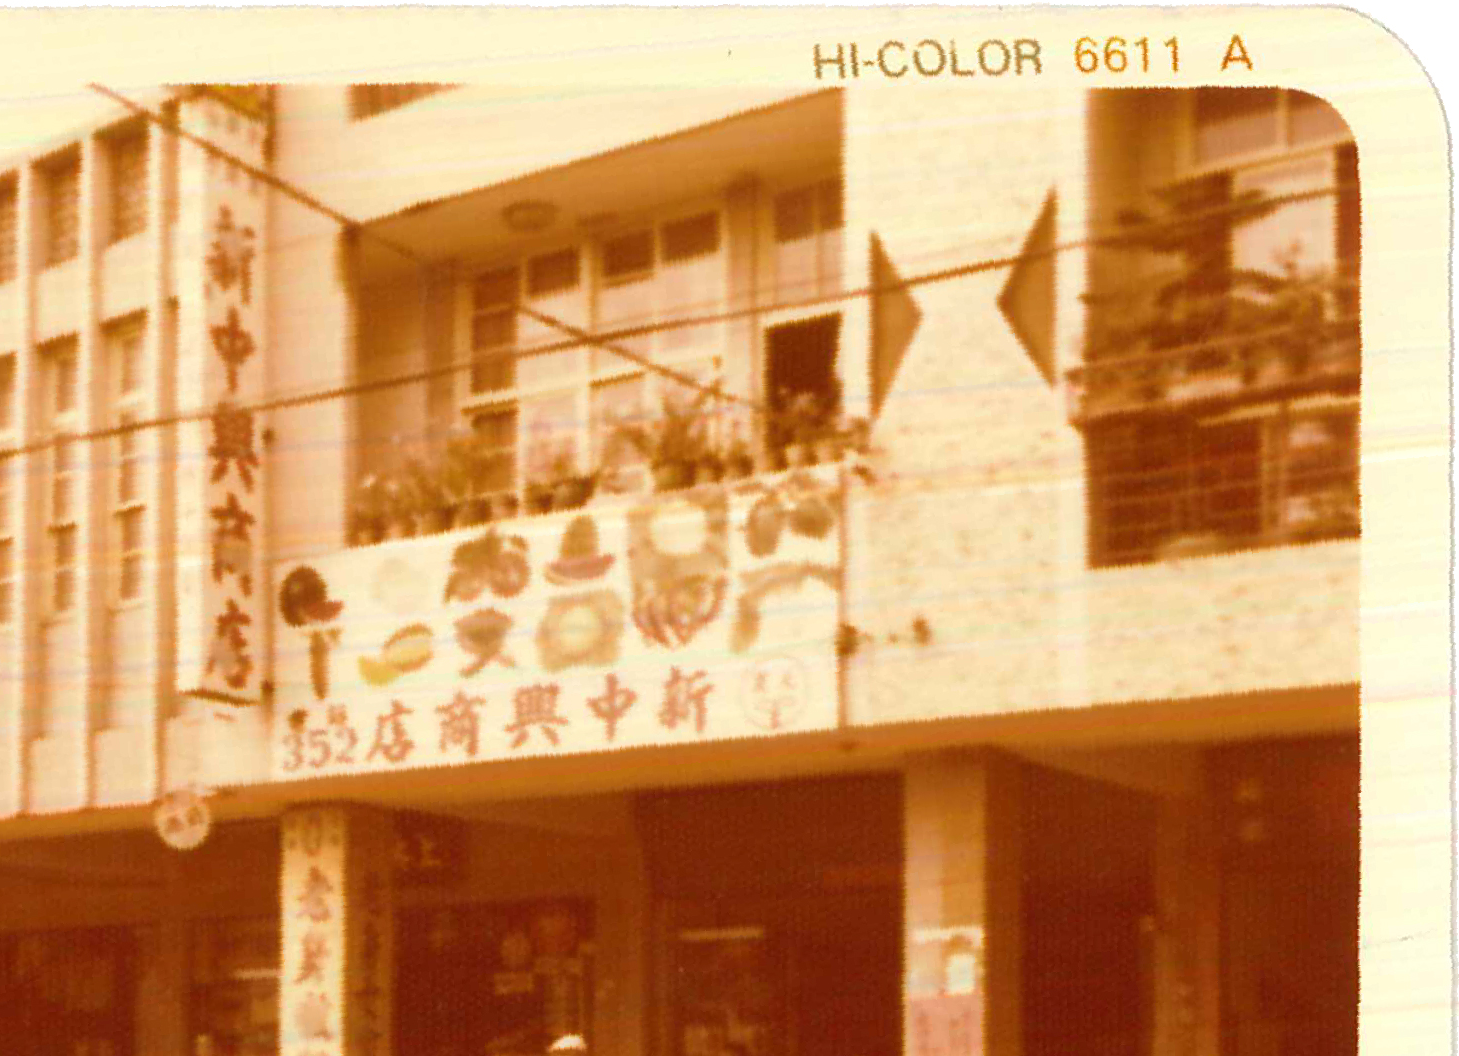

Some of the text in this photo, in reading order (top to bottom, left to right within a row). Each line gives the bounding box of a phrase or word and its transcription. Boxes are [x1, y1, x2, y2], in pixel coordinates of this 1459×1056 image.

[281, 727, 358, 770] 352
[366, 665, 713, 763] 新中興商店
